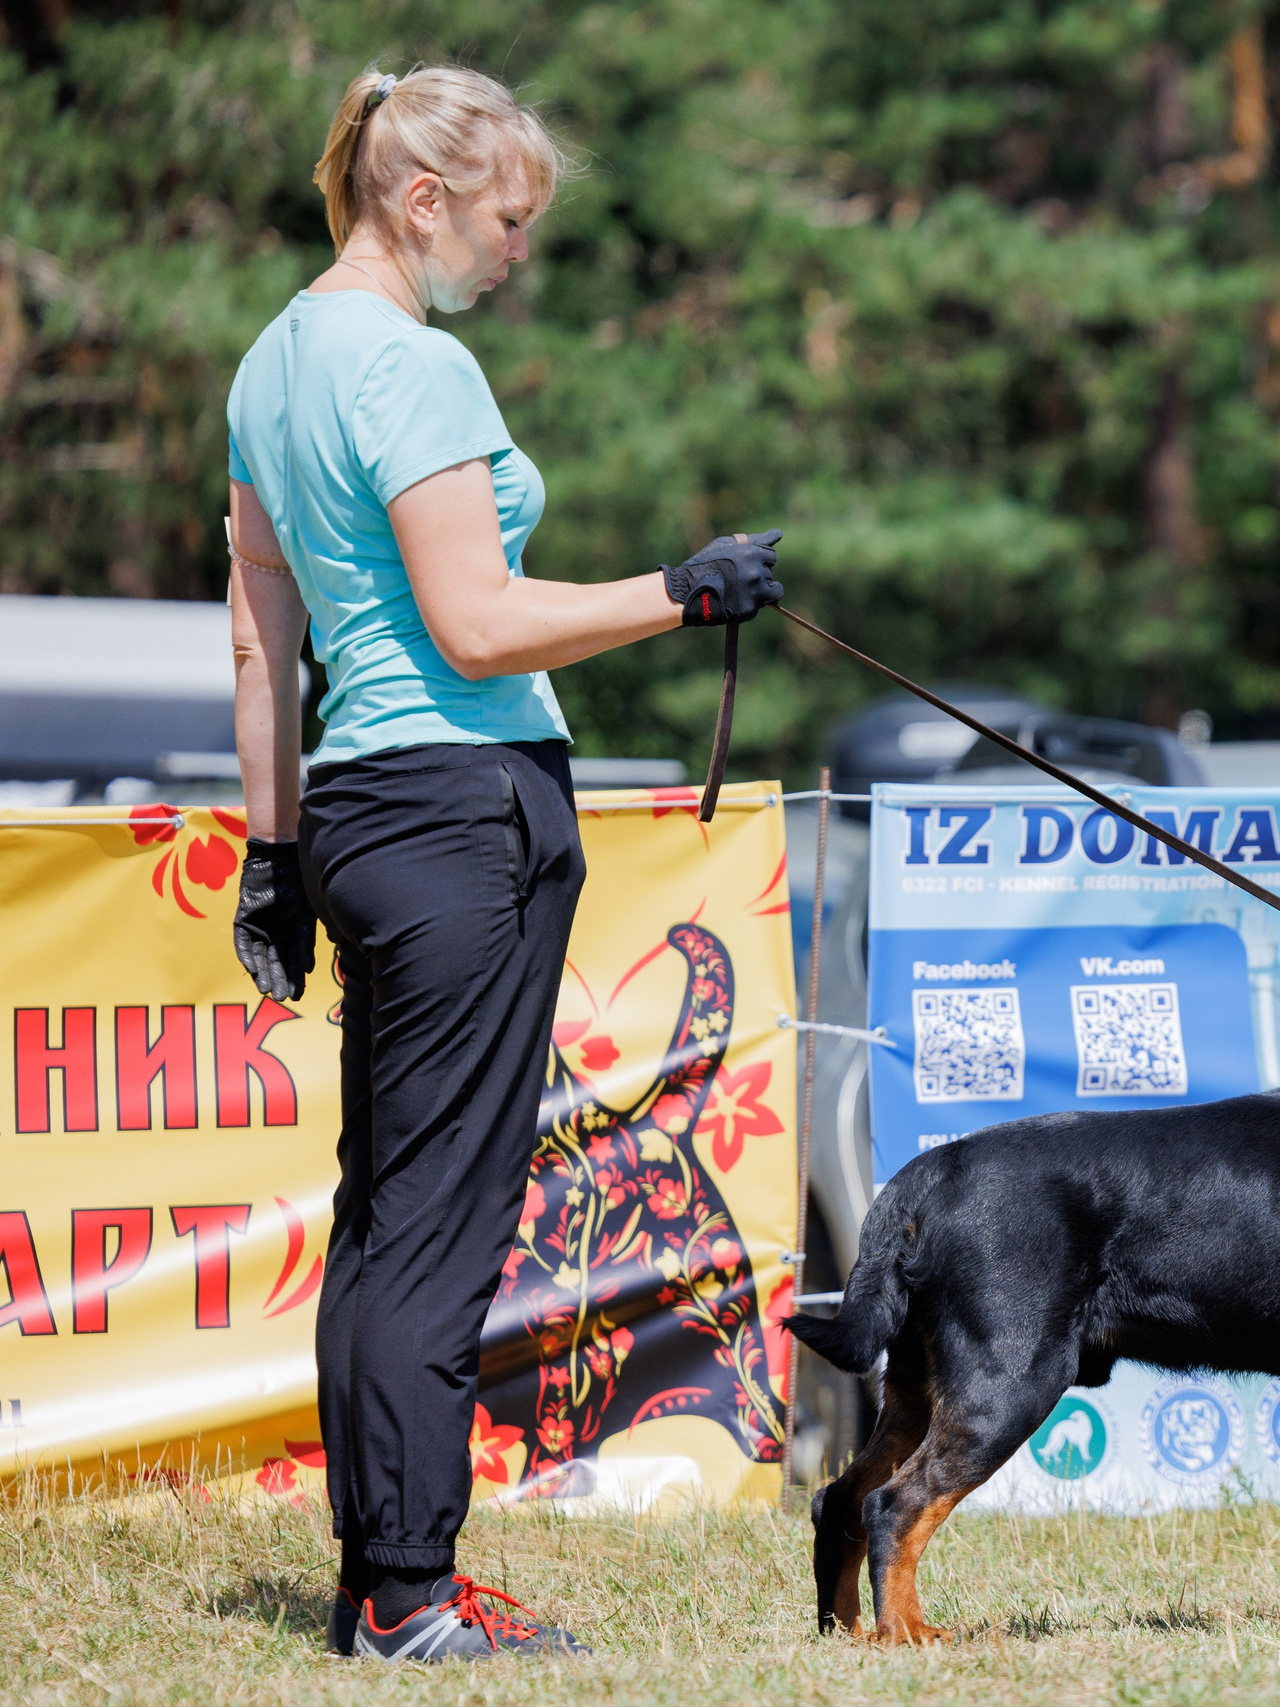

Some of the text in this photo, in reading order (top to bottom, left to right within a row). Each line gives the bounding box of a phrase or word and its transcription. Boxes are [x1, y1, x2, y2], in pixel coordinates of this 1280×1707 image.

[904, 806, 994, 866] IZ
[902, 876, 947, 893] 6322
[952, 876, 983, 893] FCI
[999, 876, 1079, 893] KENNEL
[1083, 874, 1225, 893] REGISTRATION
[913, 960, 1017, 981] Facebook
[1080, 957, 1165, 978] VK.com
[14, 995, 303, 1134] НИК
